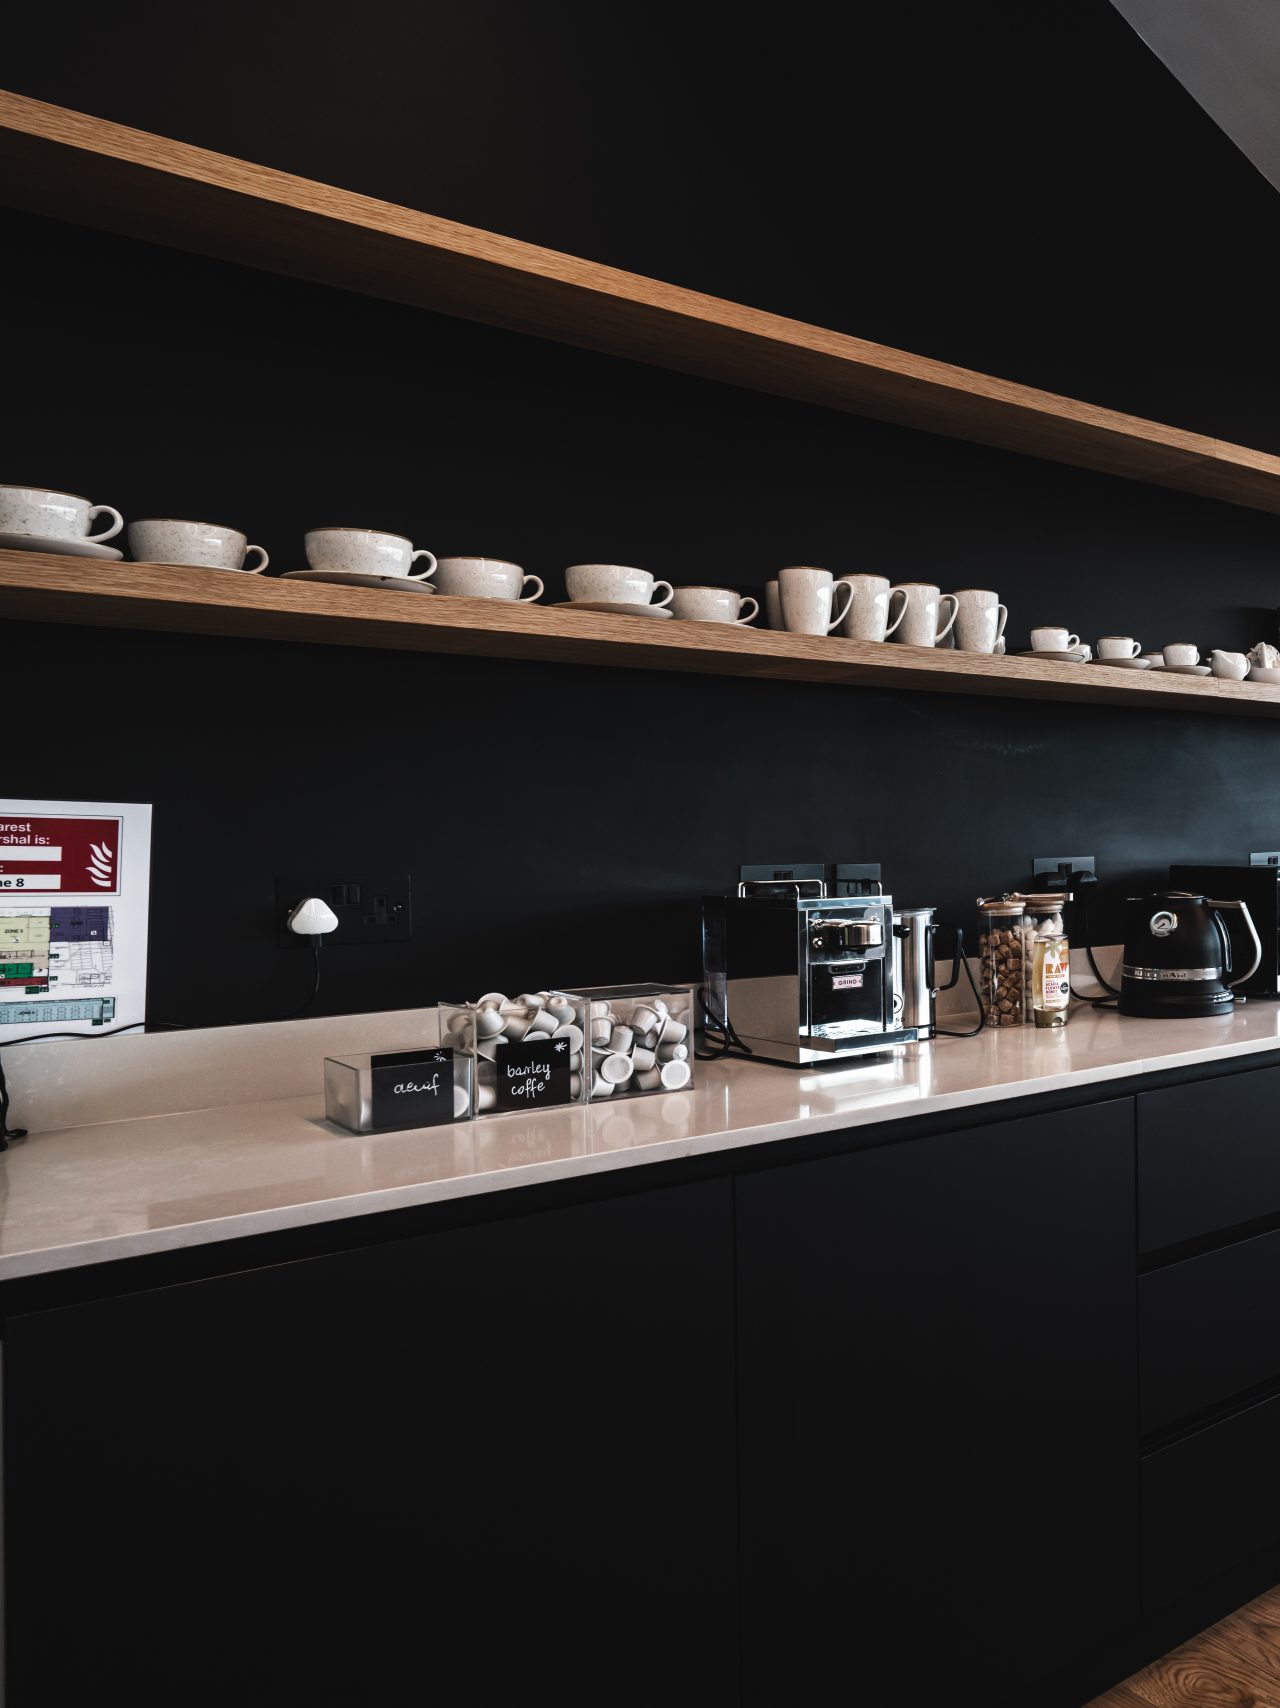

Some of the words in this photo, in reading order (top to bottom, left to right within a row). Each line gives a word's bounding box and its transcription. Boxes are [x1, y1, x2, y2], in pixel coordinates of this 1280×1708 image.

[34, 834, 50, 845] is:
[15, 877, 25, 888] 8
[1046, 963, 1068, 974] RAW
